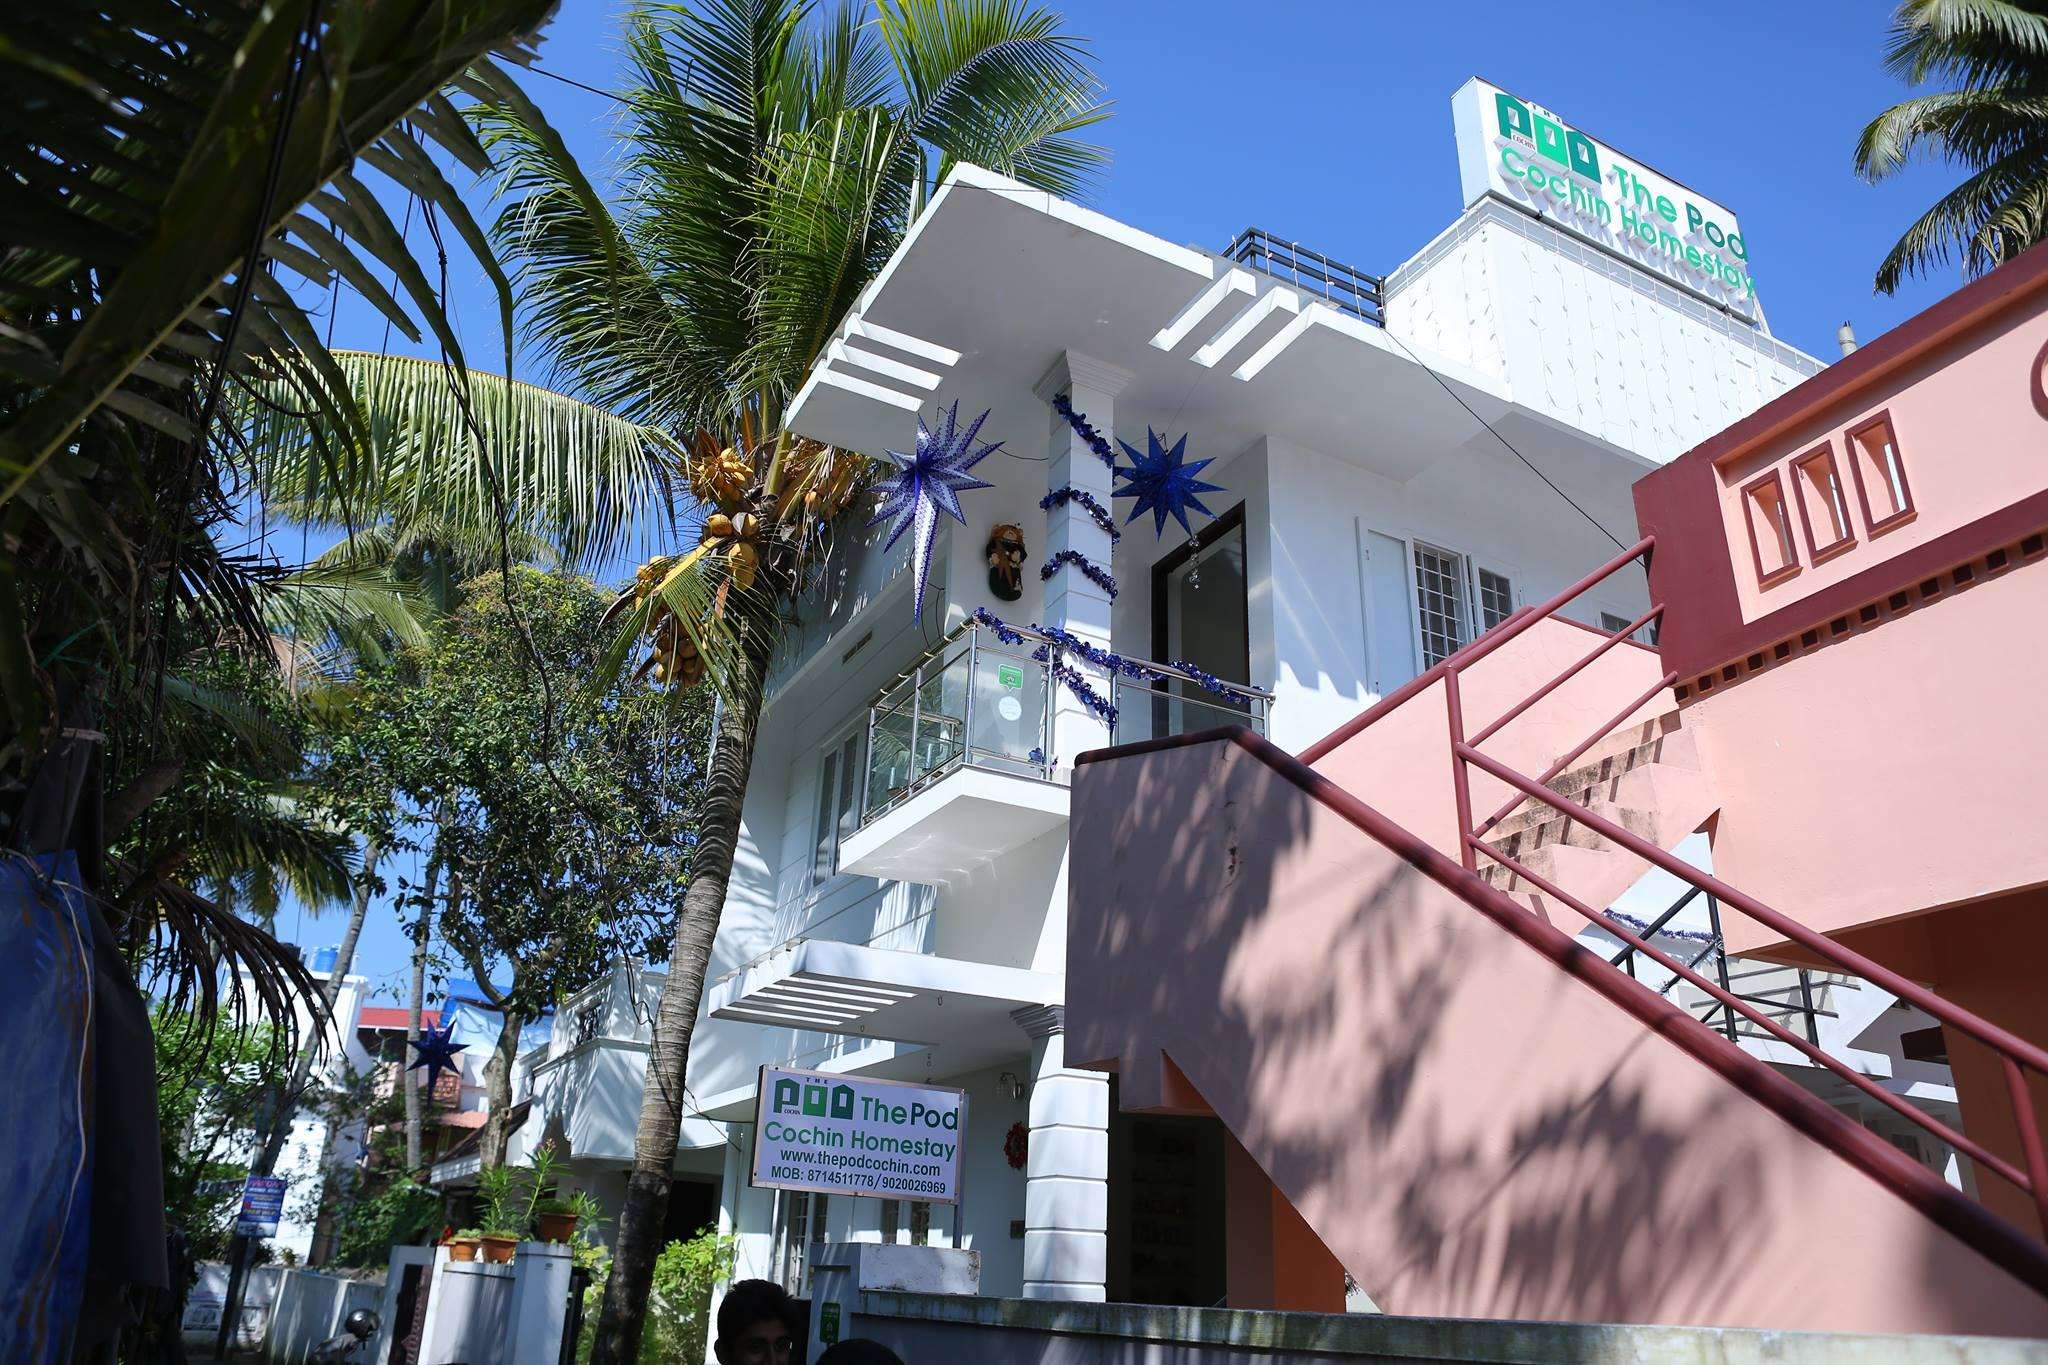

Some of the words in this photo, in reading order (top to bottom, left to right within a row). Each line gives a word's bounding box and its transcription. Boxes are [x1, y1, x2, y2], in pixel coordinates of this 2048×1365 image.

[1501, 146, 1611, 225] Cochin
[1620, 205, 1756, 298] Homestay
[1611, 164, 1677, 223] The
[1685, 202, 1748, 262] Pod
[861, 1096, 907, 1125] The
[911, 1103, 959, 1131] Pod
[765, 1121, 844, 1147] Cochin
[852, 1130, 956, 1162] Homestay
[771, 1166, 804, 1181] MOB:
[780, 1150, 940, 1176] www.thepodcochin.com
